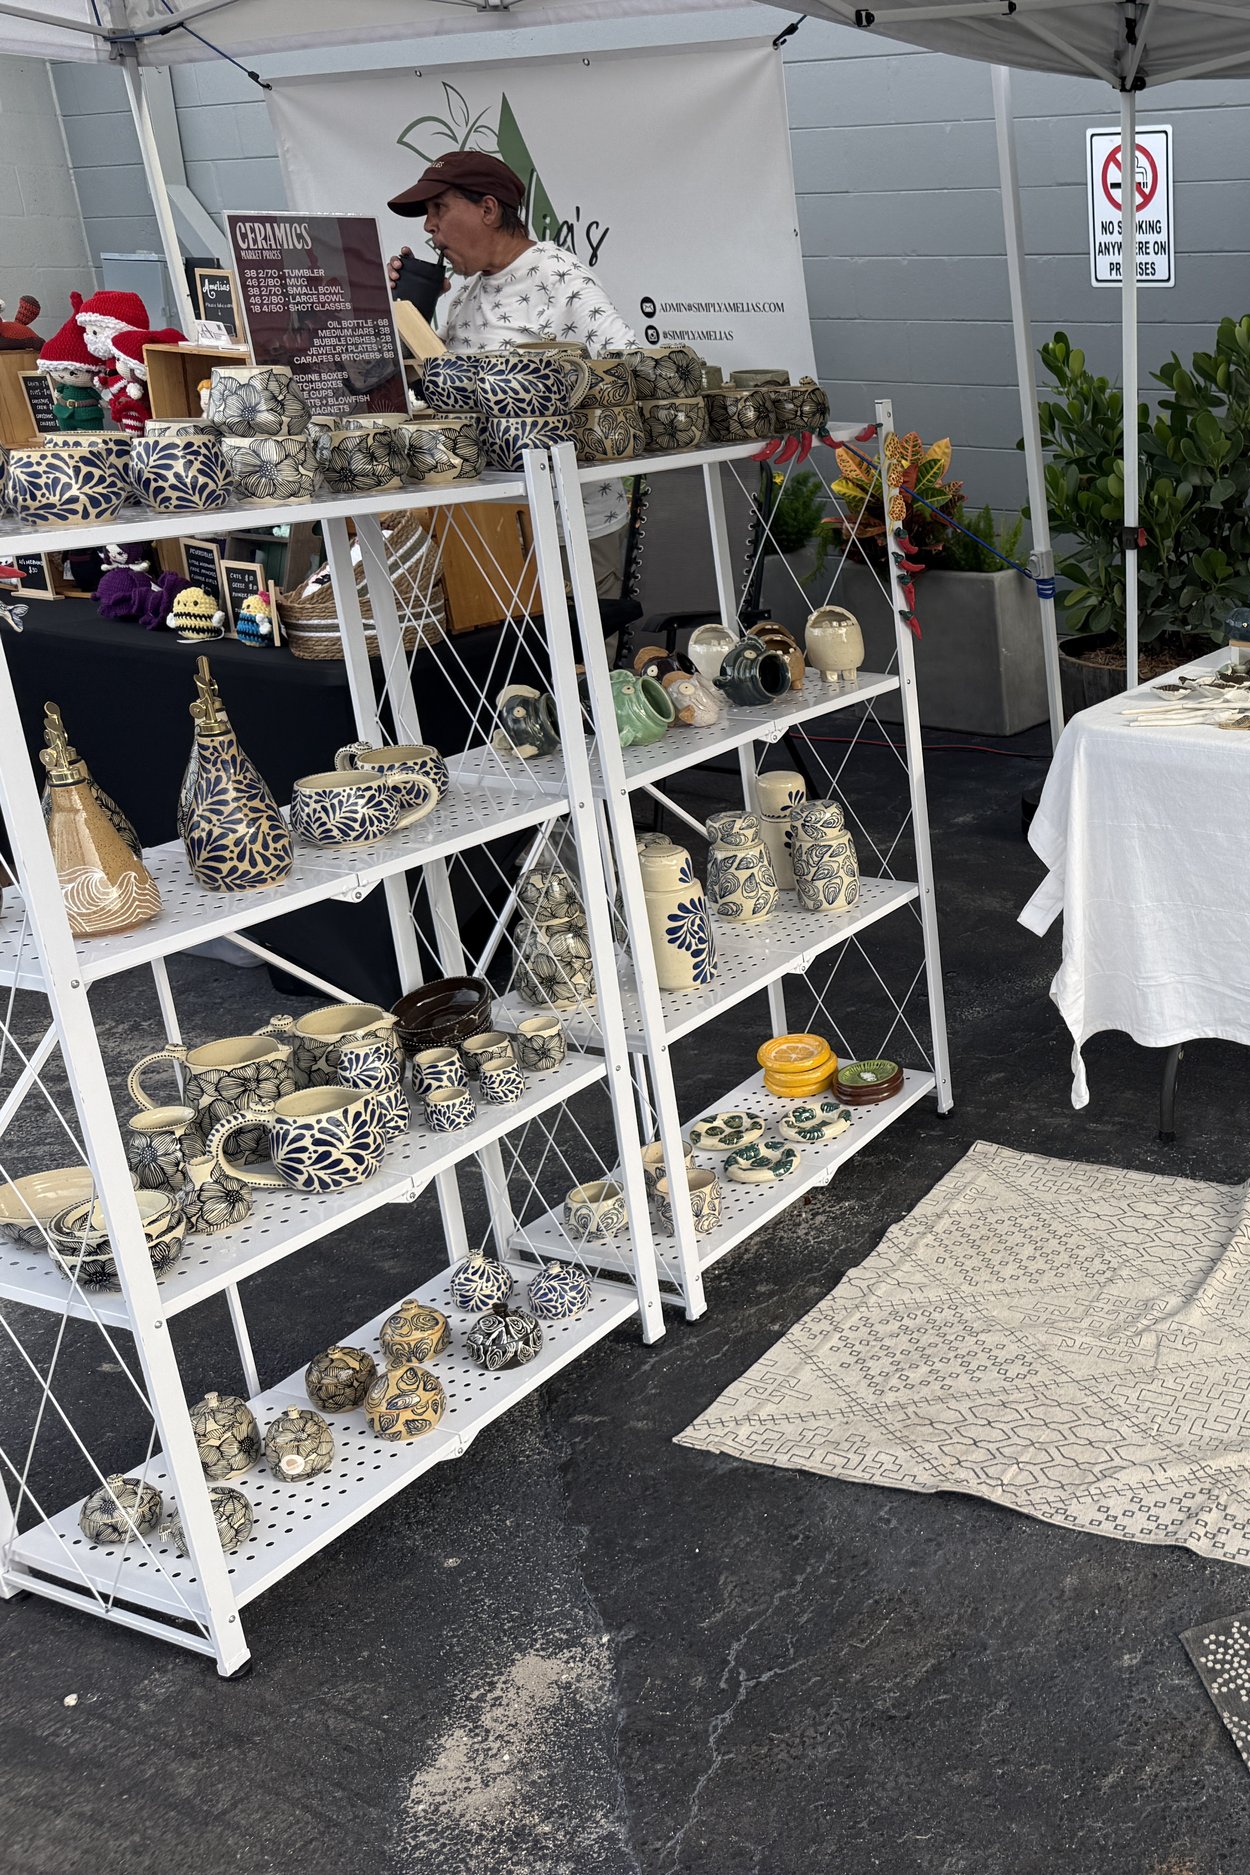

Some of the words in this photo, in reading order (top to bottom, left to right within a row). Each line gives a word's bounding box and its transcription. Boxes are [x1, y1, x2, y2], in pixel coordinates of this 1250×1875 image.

[1101, 220, 1114, 235] NO
[1118, 220, 1161, 235] SKING
[236, 222, 312, 249] CERAMICS
[1098, 241, 1150, 256] ANYWRE
[1153, 241, 1166, 255] ON
[241, 250, 262, 259] MARKET
[263, 250, 281, 259] PRICES
[283, 269, 325, 277] TUMBLER
[1110, 262, 1156, 276] PRISES
[260, 278, 280, 286] 2/80
[262, 287, 281, 295] 2/70
[263, 295, 284, 303] 2/80
[290, 295, 317, 303] LARGE
[251, 305, 261, 313] 18
[313, 303, 351, 311] GLASSES
[660, 302, 784, 313] ADMIN@SIMPLYAMELIAS.COM
[328, 320, 341, 328] OIL
[342, 320, 373, 328] BOTTLE
[318, 329, 352, 337] MEDIUM
[663, 330, 734, 341] @SIMPLYAMELIAS
[314, 337, 346, 346] BUBBLE
[347, 336, 376, 344] DISHES
[308, 346, 346, 355] JEWELRY
[348, 344, 377, 352] PLATES
[294, 355, 333, 364] CARAFES
[342, 352, 380, 361] PITCHERS
[294, 374, 320, 382] RDINE
[321, 372, 348, 380] BOXES
[298, 381, 343, 391] TCHBOXES
[310, 390, 333, 398] CUPS
[328, 395, 370, 405] BLOWFISH
